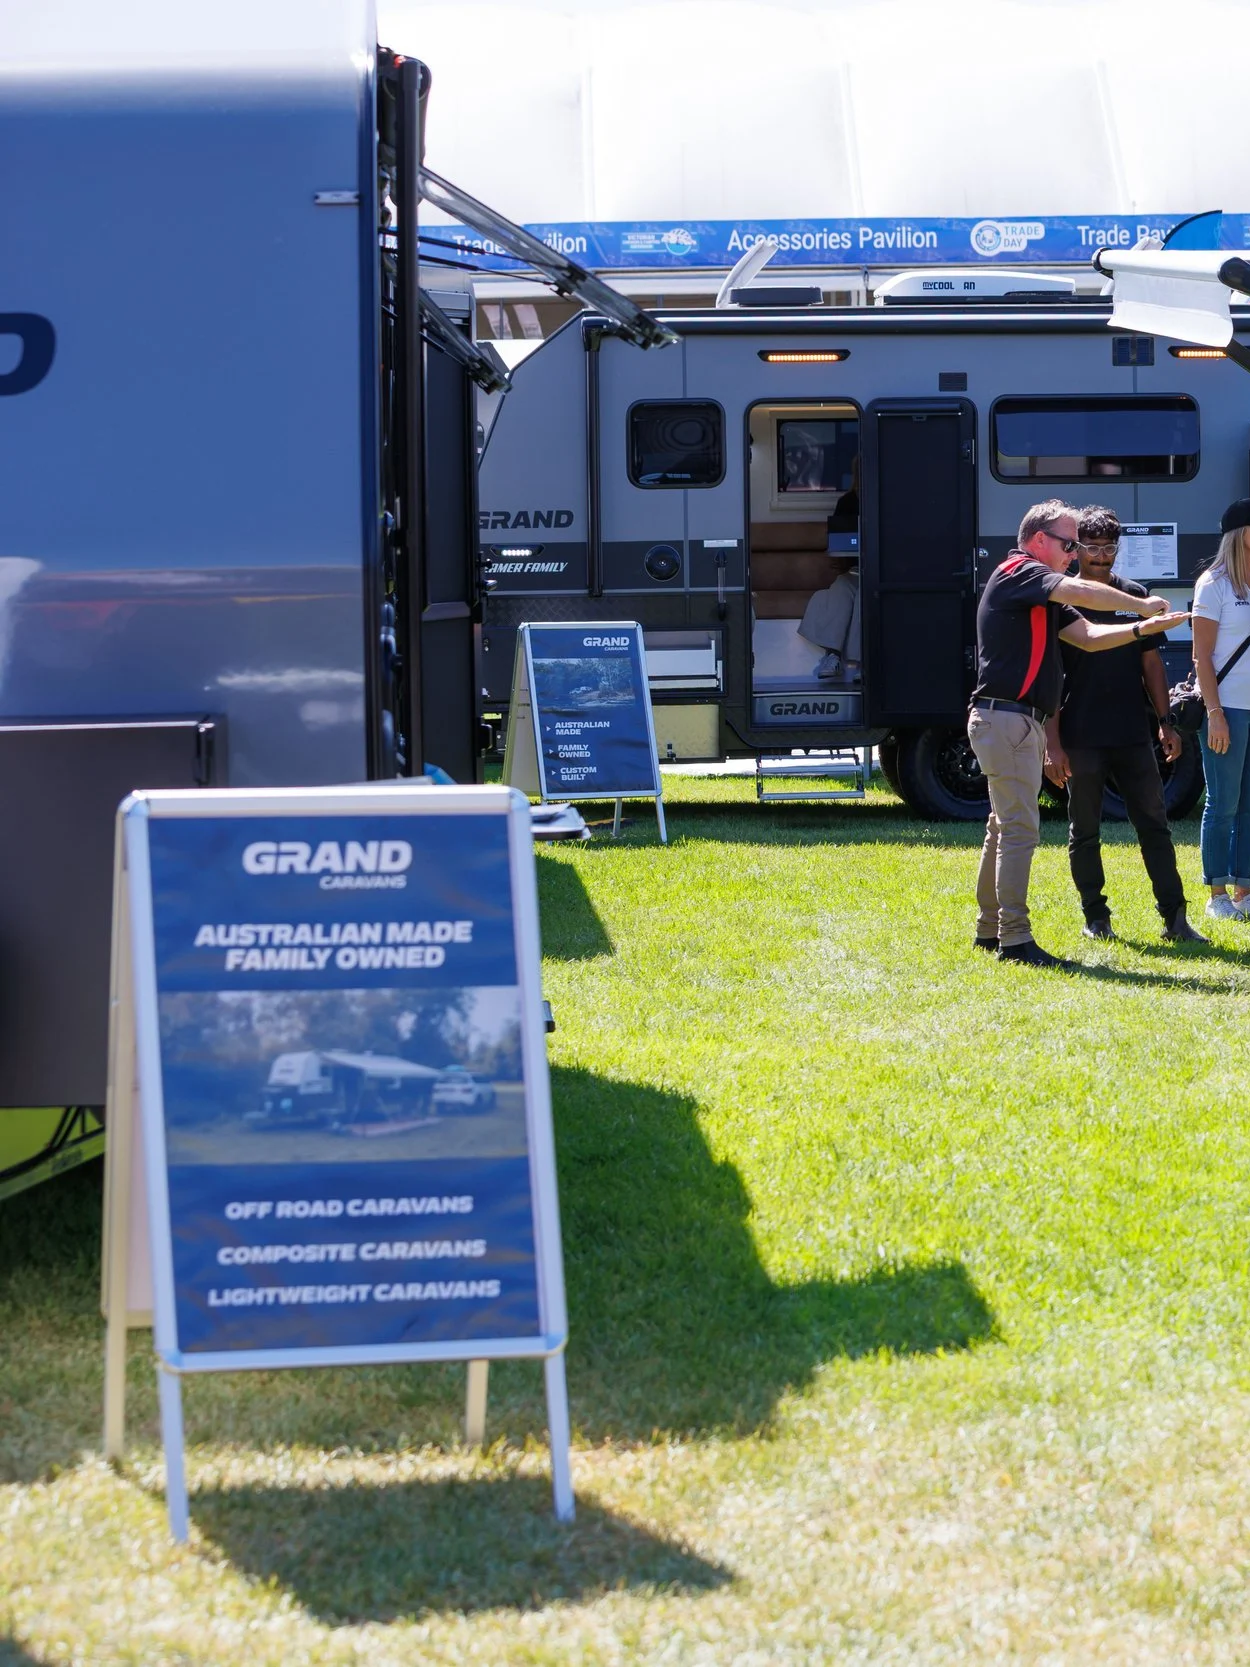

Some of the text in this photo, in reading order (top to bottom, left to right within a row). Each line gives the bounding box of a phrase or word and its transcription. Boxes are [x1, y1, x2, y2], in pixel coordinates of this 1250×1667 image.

[859, 226, 938, 249] Pavilion
[1004, 225, 1040, 235] TRADE
[1077, 224, 1130, 246] Trade
[1003, 238, 1022, 248] DAY
[479, 510, 574, 530] GRAND
[523, 562, 569, 573] FAMILY
[583, 636, 630, 647] GRAND
[769, 702, 840, 716] GRAND
[242, 840, 413, 875] GRAND
[319, 875, 408, 890] CARAVANS
[194, 921, 474, 946] AUSTRALIAN MADE
[224, 946, 446, 971] FAMILY OWNED
[224, 1195, 474, 1220] OFF ROAD CARAVANS
[217, 1239, 487, 1265] COMPOSITE CARAVANS
[207, 1279, 501, 1307] LIGHTWEIGHT CARAVANS
